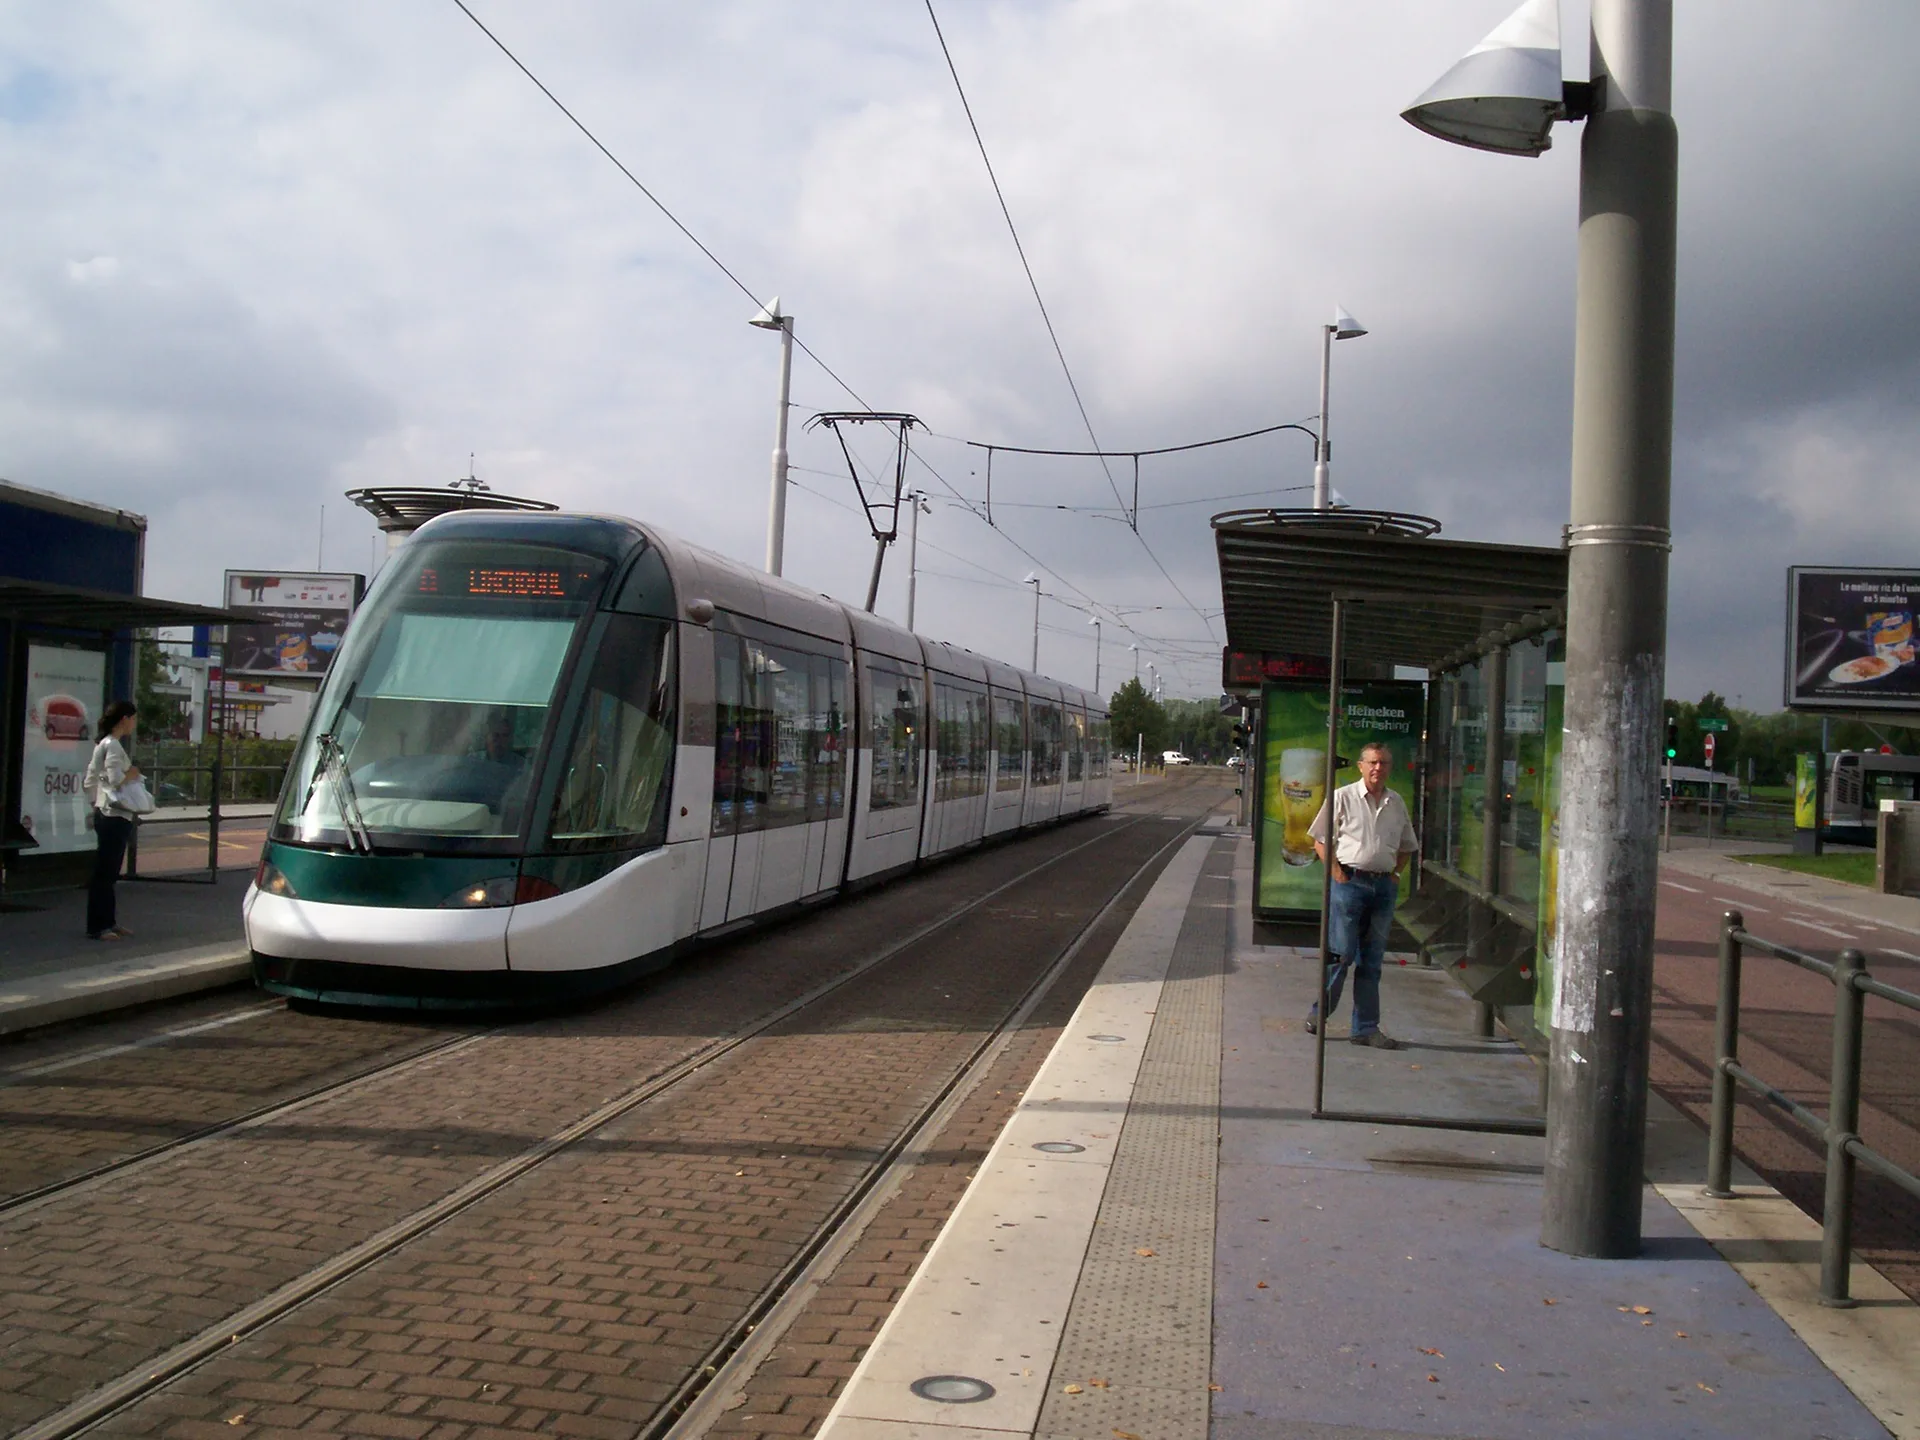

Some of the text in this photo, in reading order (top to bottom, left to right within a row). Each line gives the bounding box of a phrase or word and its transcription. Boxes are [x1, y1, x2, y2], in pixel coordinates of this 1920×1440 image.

[1348, 704, 1405, 718] Heineken
[1348, 717, 1410, 733] refreshing
[44, 773, 80, 795] 6490
